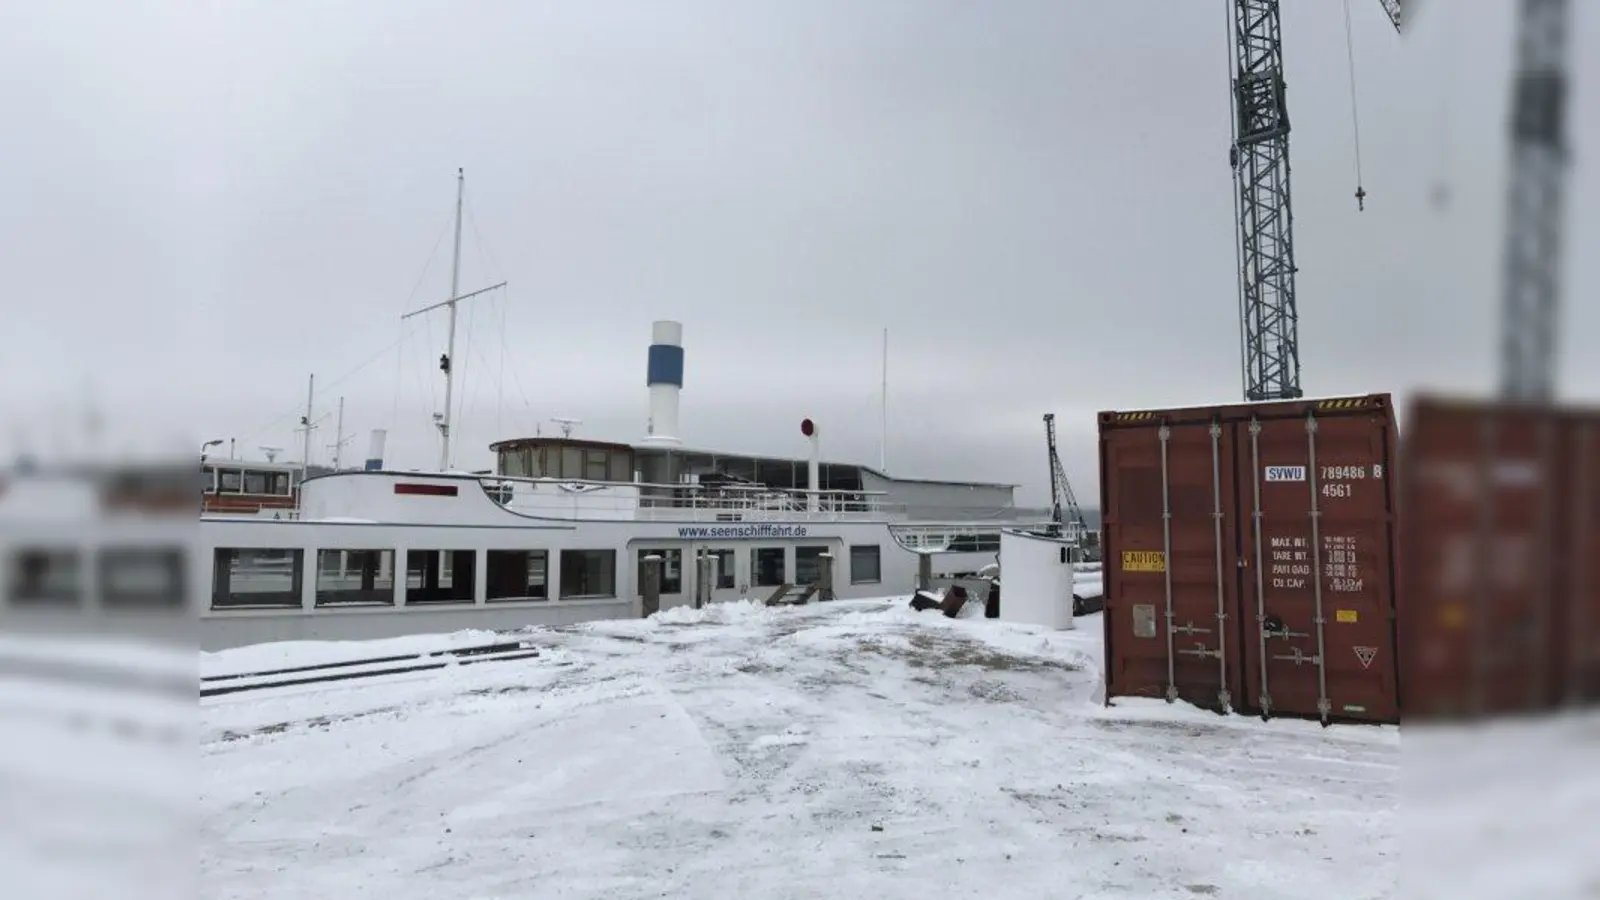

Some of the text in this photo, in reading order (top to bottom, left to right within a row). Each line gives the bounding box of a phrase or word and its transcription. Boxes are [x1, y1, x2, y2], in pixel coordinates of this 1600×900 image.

[1269, 467, 1302, 479] SVWU
[1321, 466, 1365, 479] 789486
[678, 524, 807, 537] www.seenschifffahrt.de
[1273, 551, 1291, 560] TARE
